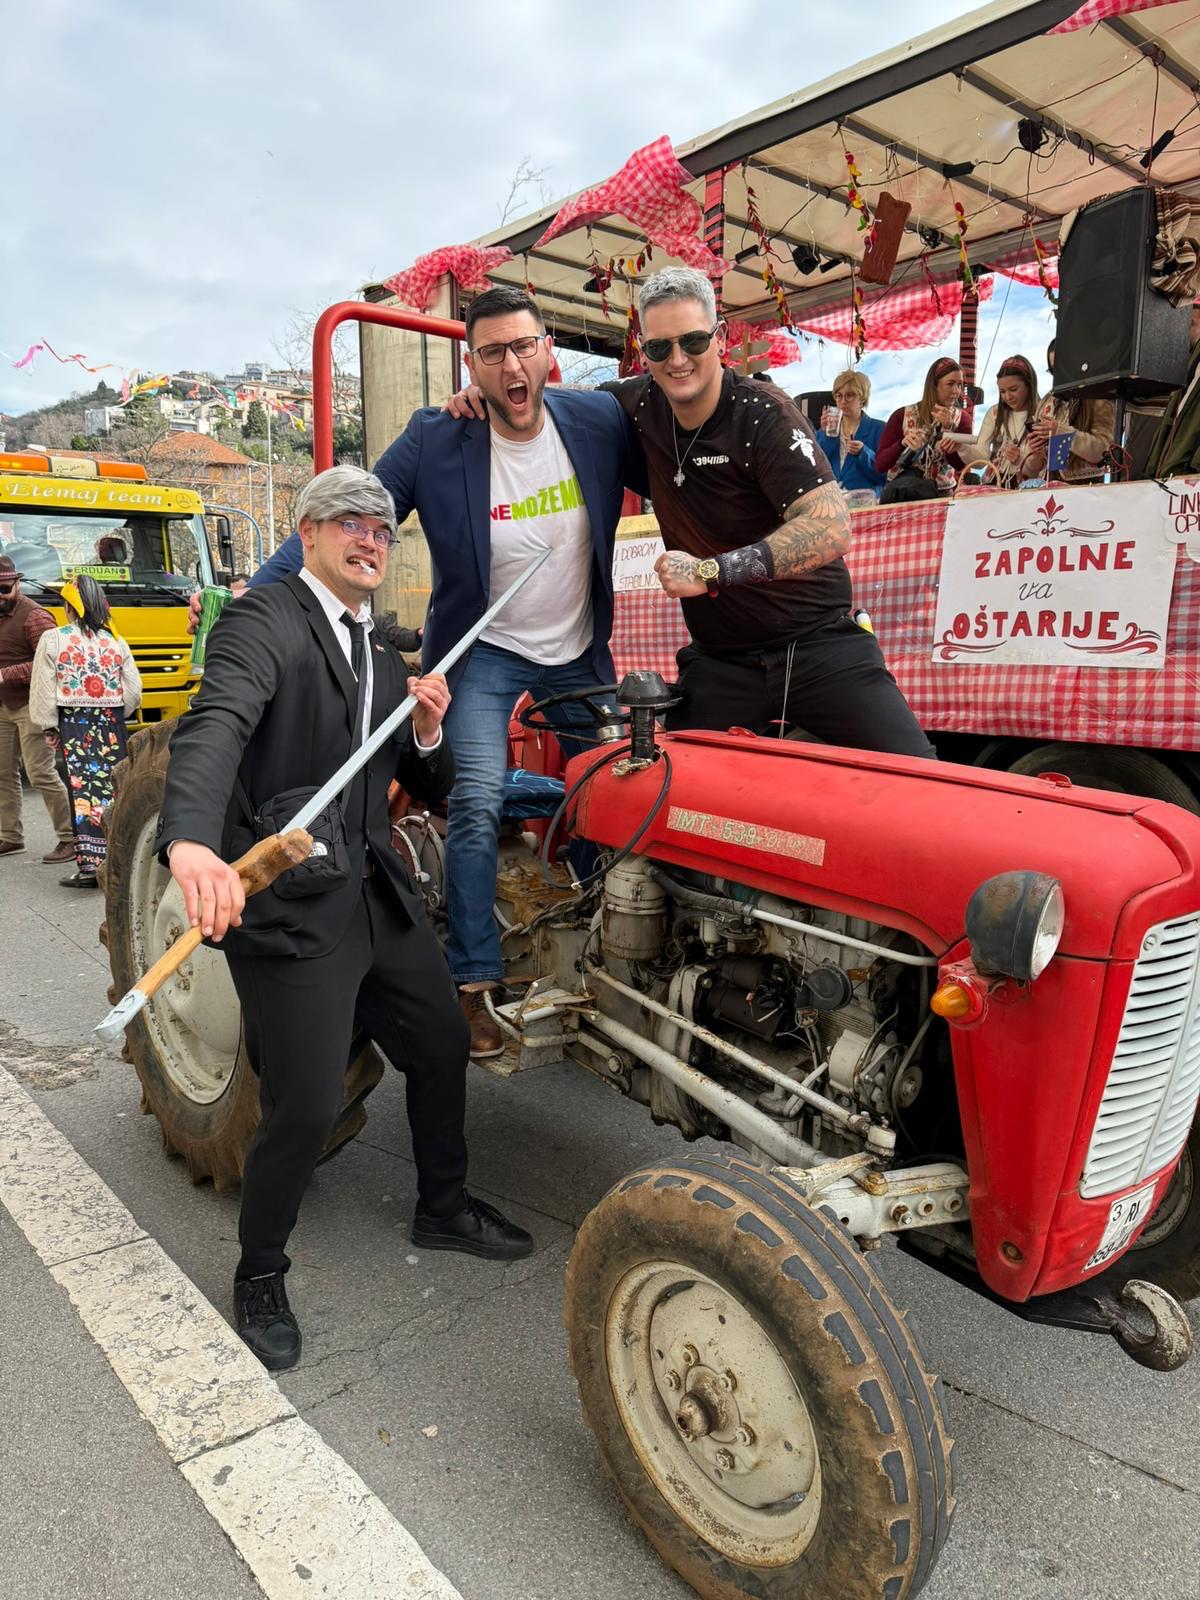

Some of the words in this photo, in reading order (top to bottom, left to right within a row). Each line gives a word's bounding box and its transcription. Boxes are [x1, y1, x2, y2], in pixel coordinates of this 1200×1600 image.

[108, 490, 163, 505] team
[1175, 514, 1200, 533] OP
[621, 541, 657, 561] DOBROM
[975, 540, 1136, 578] ZAPOLNE
[73, 566, 119, 575] ERDUAN
[952, 605, 1120, 640] OŠTARIJE
